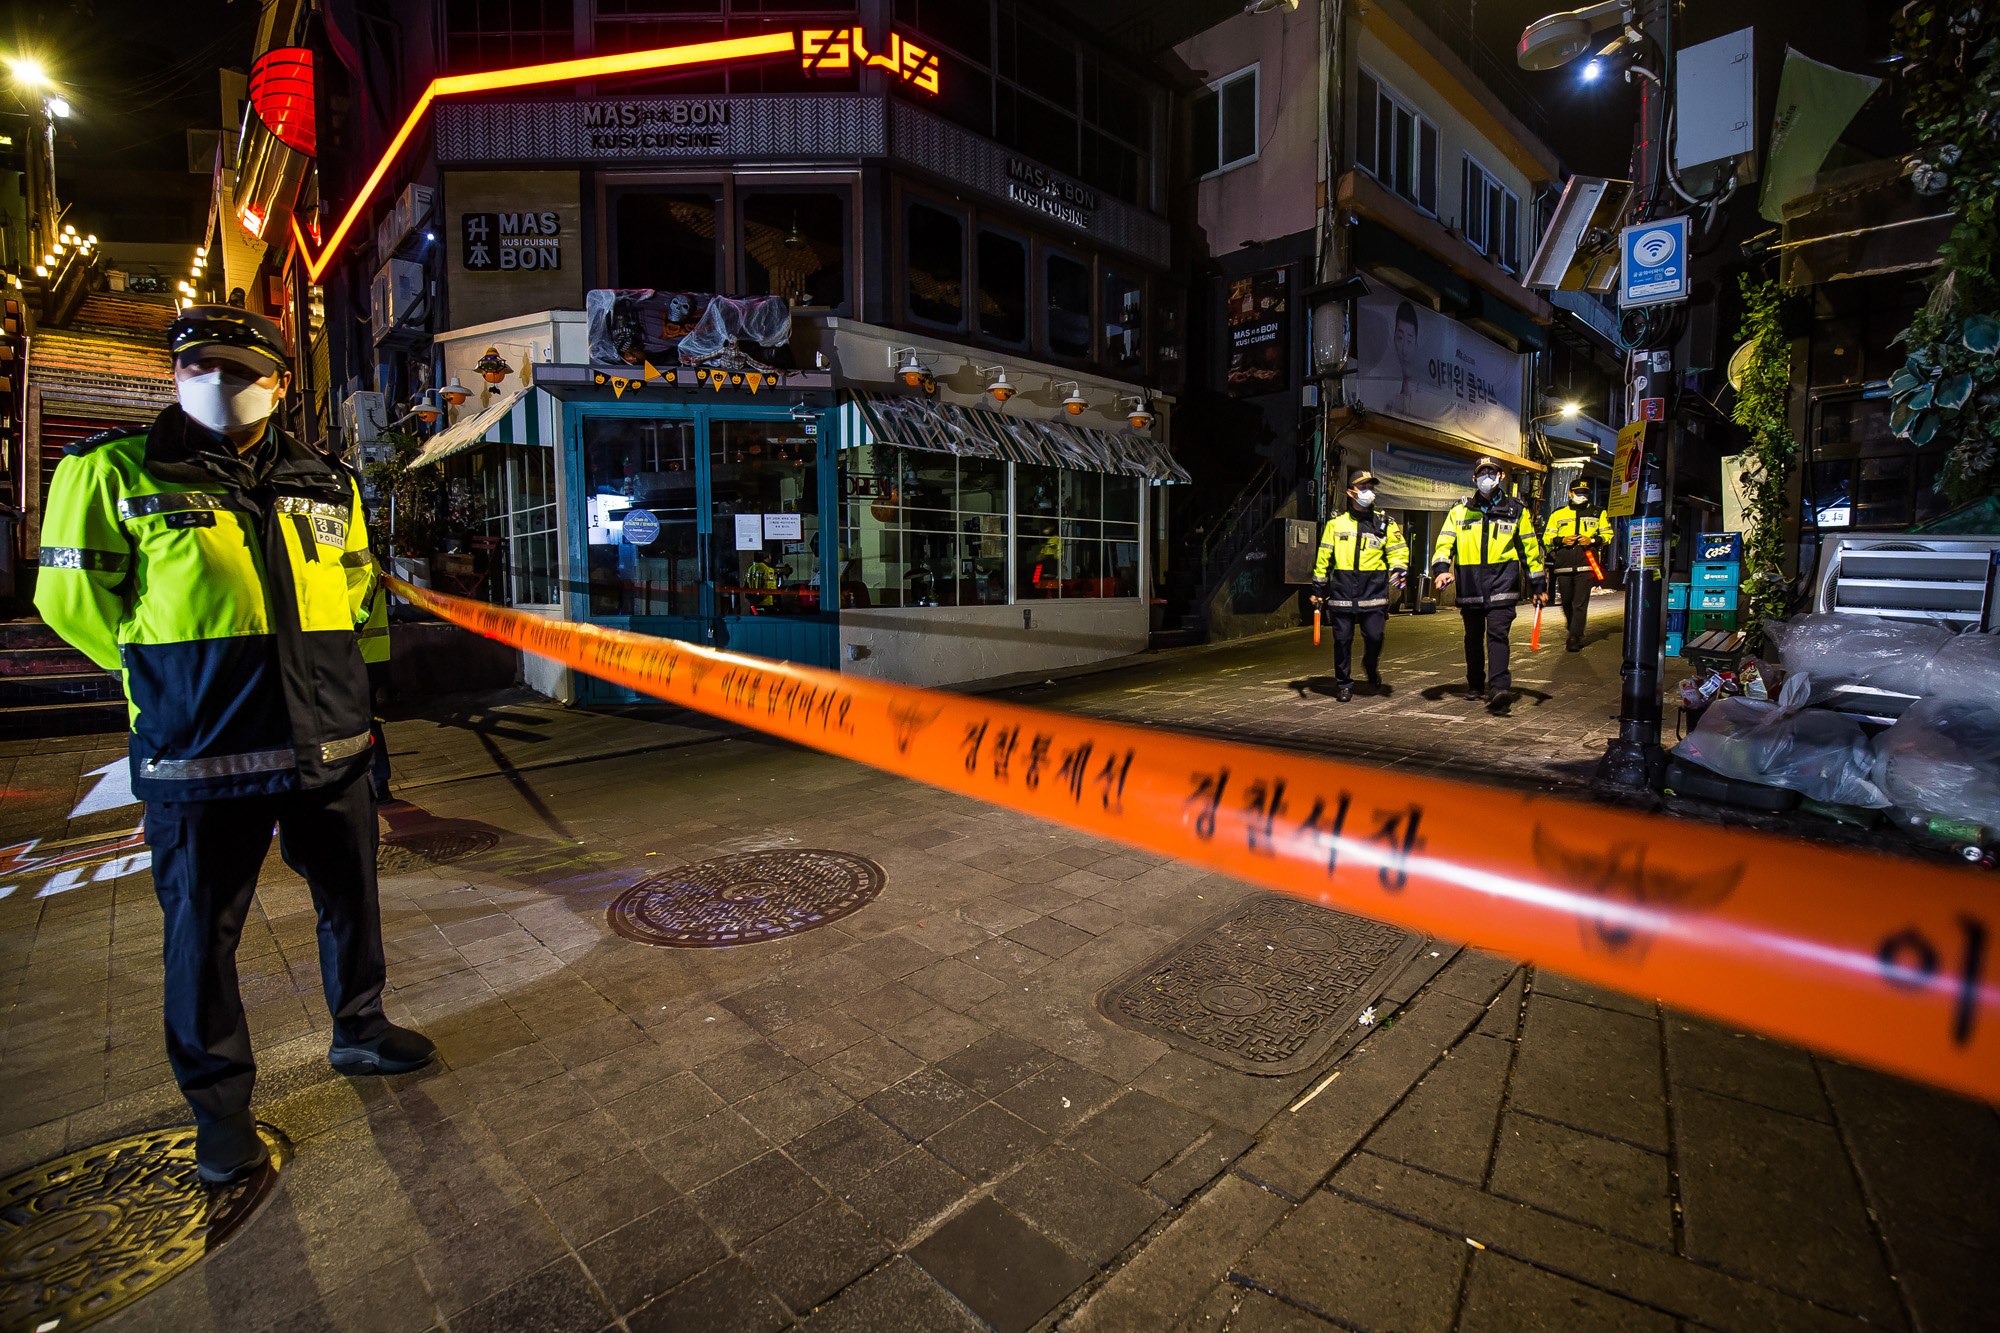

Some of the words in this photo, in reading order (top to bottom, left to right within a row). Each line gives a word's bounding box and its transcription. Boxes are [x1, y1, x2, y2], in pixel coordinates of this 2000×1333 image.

[583, 105, 638, 126] MAS
[673, 104, 729, 125] BON
[592, 135, 635, 149] KUSI
[642, 133, 720, 148] CUISINE
[1010, 159, 1044, 189] MAS
[1064, 183, 1095, 210] BON
[1009, 184, 1039, 208] KUSI
[1041, 198, 1087, 228] CUISINE
[498, 212, 559, 235] MAS
[500, 247, 559, 269] BON
[1234, 332, 1250, 340] MAS
[1261, 322, 1278, 334] BON
[1235, 338, 1250, 347] KUSI
[1250, 332, 1276, 344] CUISINE
[1428, 358, 1464, 399] 이태원
[1466, 371, 1498, 405] 클라쓰
[845, 476, 890, 496] OPEN
[316, 518, 342, 537] 경찰
[319, 534, 343, 546] POLICE
[1705, 544, 1731, 559] Cass
